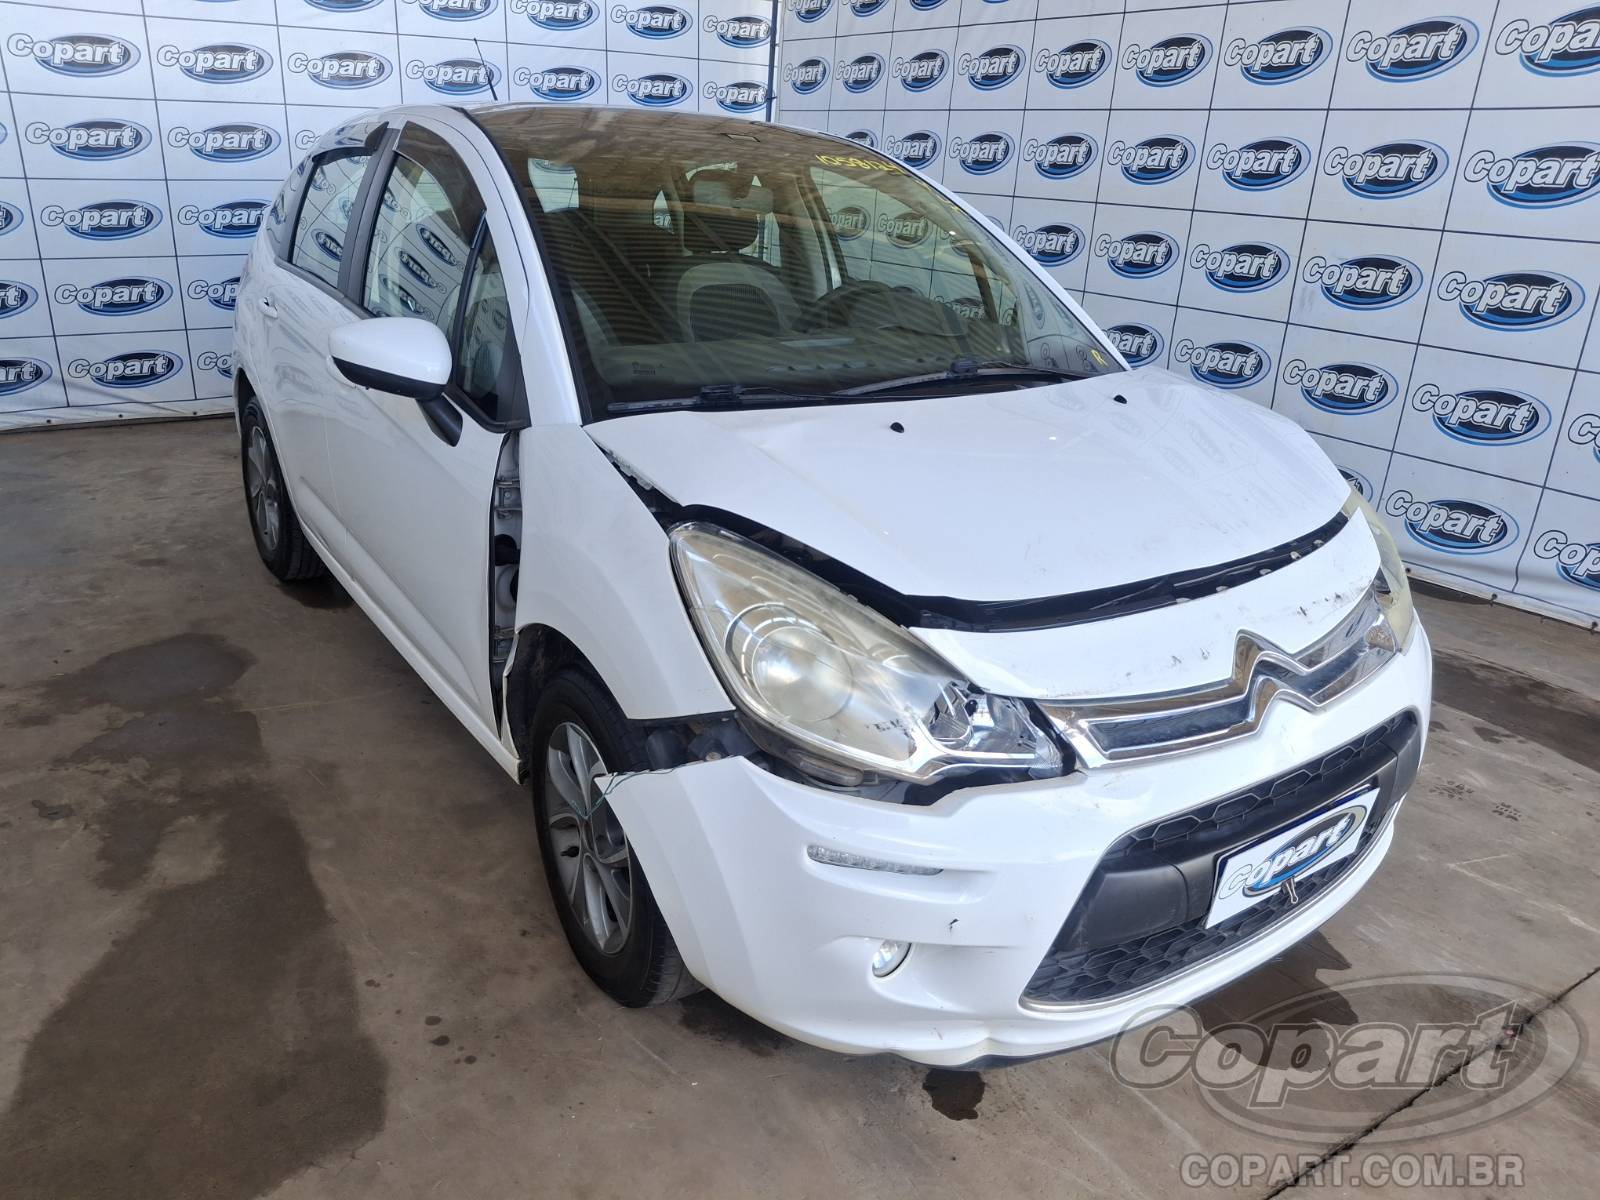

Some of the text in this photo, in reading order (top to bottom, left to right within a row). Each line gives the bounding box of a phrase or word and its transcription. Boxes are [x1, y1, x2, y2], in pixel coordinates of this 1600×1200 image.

[611, 5, 683, 30] Copart
[703, 15, 769, 38] Copart
[7, 33, 125, 66] Copart
[1122, 38, 1202, 75] Copart
[1223, 32, 1321, 73] Copart
[1346, 23, 1464, 71] Copart
[1495, 19, 1600, 62] Copa
[157, 45, 258, 74] Copart
[287, 53, 380, 80] Copart
[405, 59, 489, 88] Copart
[784, 62, 825, 86] Copart
[835, 58, 879, 85] Copart
[892, 54, 944, 83] Copart
[957, 49, 1019, 81] Copart
[1034, 44, 1105, 75] Copart
[513, 67, 590, 94] Copart
[612, 74, 683, 97] Copart
[703, 81, 766, 104] Copart
[25, 122, 138, 150] Copart
[168, 126, 267, 153] Copart
[884, 136, 935, 160] Copart
[950, 135, 1006, 168] Copart
[1024, 137, 1090, 170] Copart
[1107, 139, 1186, 172] Copart
[1206, 143, 1298, 179] Copart
[1324, 147, 1433, 185] Copart
[1464, 150, 1600, 193] Copart
[41, 205, 149, 232] Copart
[1013, 225, 1079, 254] Copart
[1095, 234, 1170, 266] Copart
[1190, 243, 1280, 279] Copart
[1302, 256, 1408, 296] Copart
[55, 281, 159, 307] Copart
[187, 280, 240, 302] Cop
[1437, 271, 1568, 315] Copart
[1101, 329, 1154, 357] part
[1174, 338, 1261, 377] Copart
[68, 353, 171, 380] Copart
[1282, 359, 1386, 403] Copart
[1412, 383, 1533, 433] Copart
[1385, 489, 1502, 544] Copart
[1533, 529, 1600, 578] Cop
[1218, 812, 1352, 899] Copart
